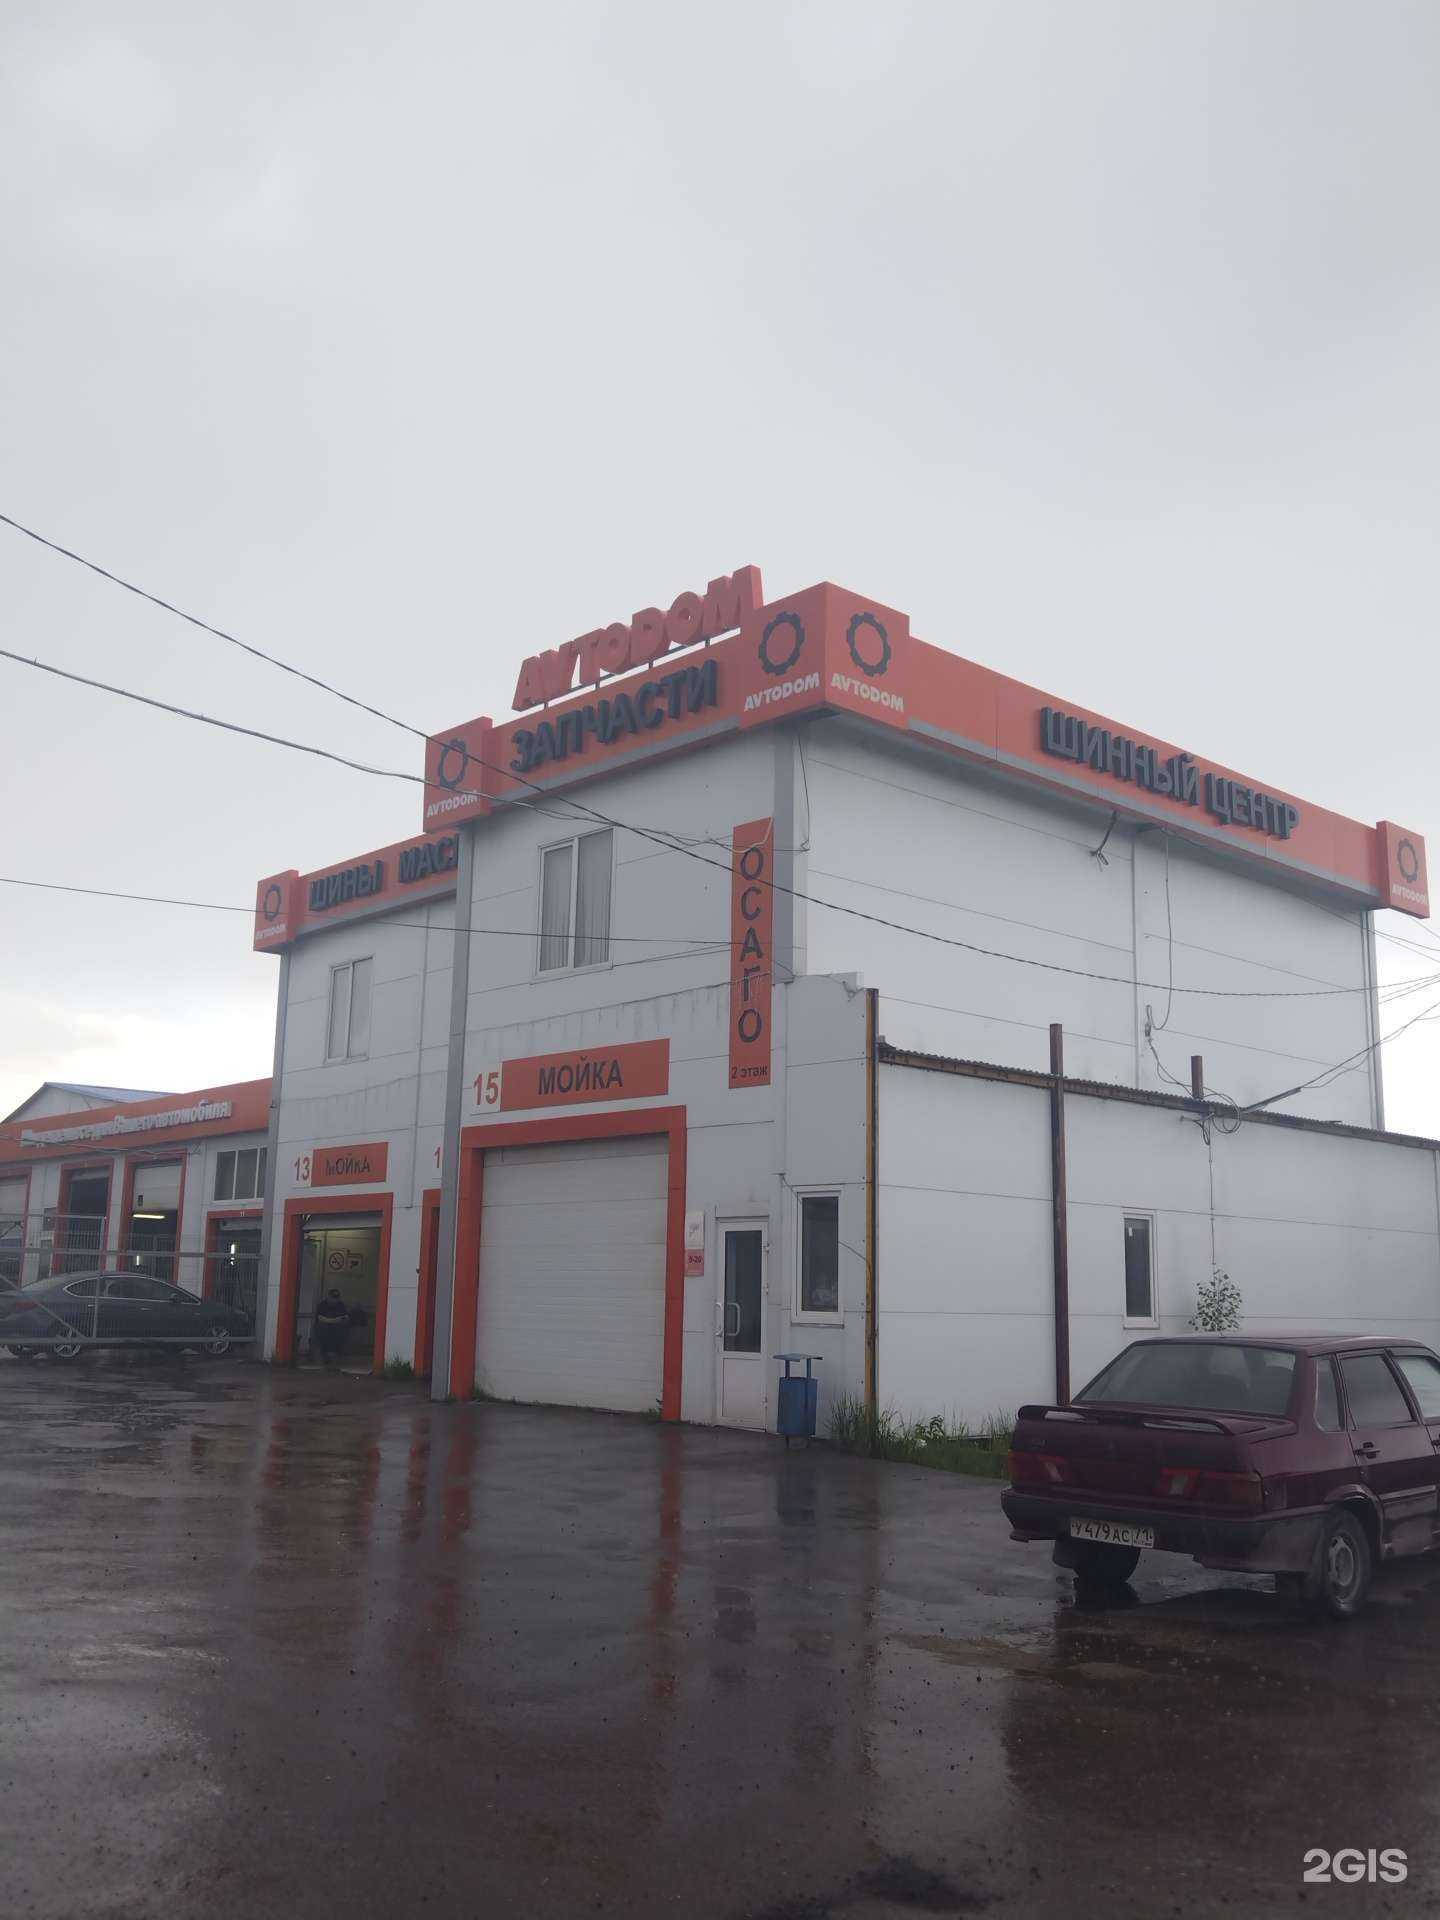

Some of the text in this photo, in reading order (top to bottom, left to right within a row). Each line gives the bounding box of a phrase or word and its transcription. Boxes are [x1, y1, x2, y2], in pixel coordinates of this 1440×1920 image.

[511, 565, 764, 711] AVTODOM
[744, 672, 820, 712] AVTODOM
[831, 673, 904, 713] AVTODOM
[510, 659, 718, 772] ЗАПЧАСТИ
[1040, 707, 1300, 839] ШИННЫЙ ЦЕНТР
[427, 790, 478, 818] AVTODOM
[309, 859, 384, 911] ШИНЫ
[737, 846, 764, 1043] ОСАГО
[473, 1072, 499, 1106] 15
[538, 1056, 623, 1095] МОЙКА
[731, 1065, 769, 1080] 2 этаж
[294, 1157, 310, 1181] 13
